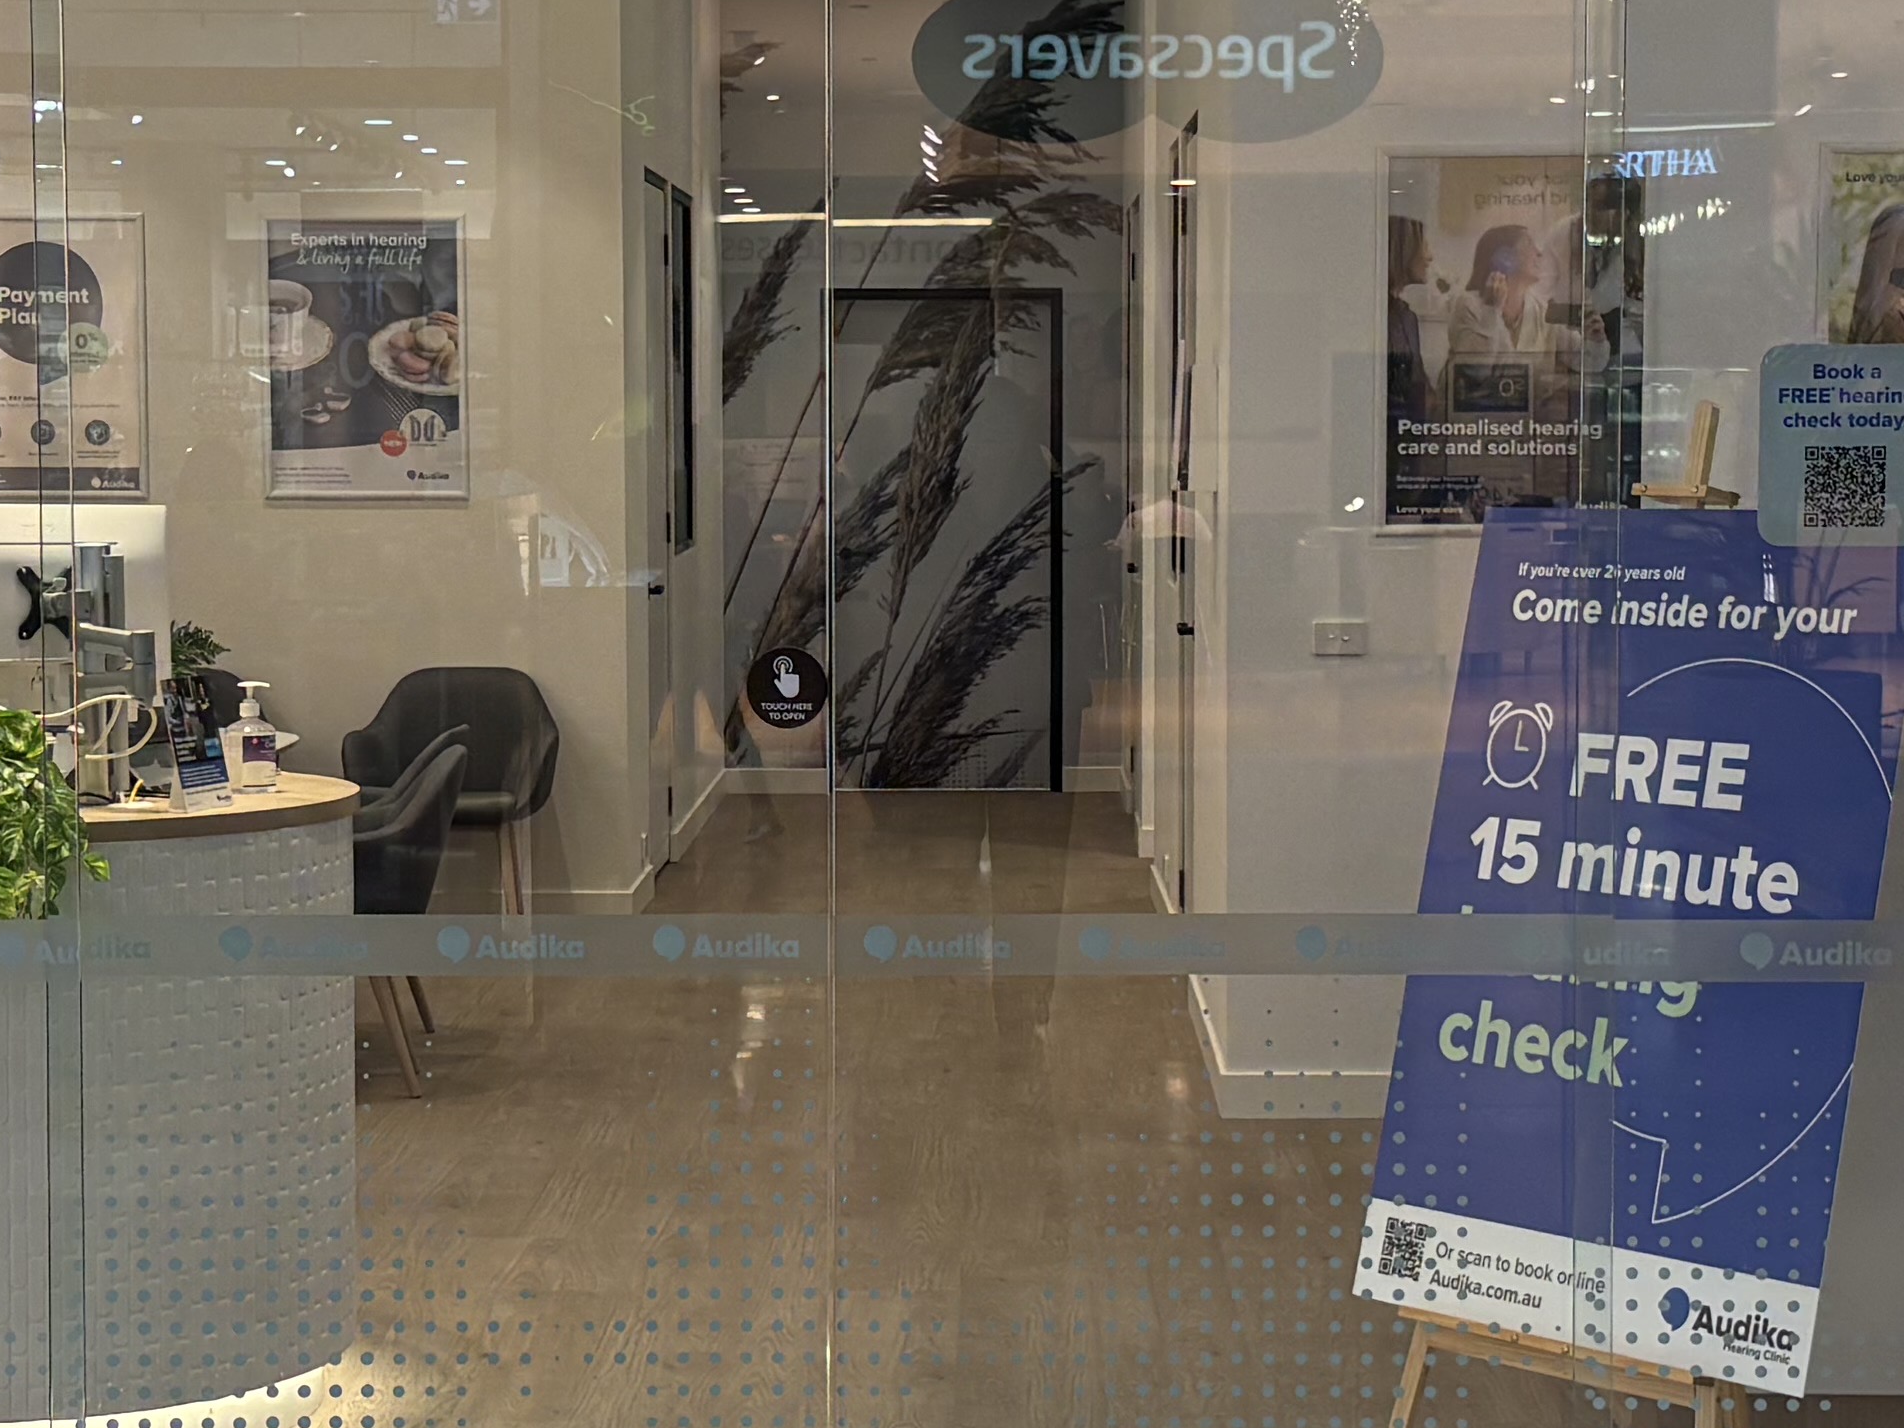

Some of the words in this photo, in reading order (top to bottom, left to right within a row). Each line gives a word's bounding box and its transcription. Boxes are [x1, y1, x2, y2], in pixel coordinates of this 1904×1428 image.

[291, 233, 347, 247] Experts
[351, 233, 365, 246] in
[369, 233, 428, 249] hearing
[1813, 363, 1865, 380] Book
[1869, 367, 1882, 380] a
[1397, 418, 1523, 436] Personalised
[1528, 418, 1602, 439] hearing
[1783, 412, 1842, 429] check
[1397, 441, 1439, 456] care
[1445, 439, 1482, 456] and
[1487, 439, 1578, 456] solutions
[1517, 562, 1530, 577] If
[1624, 566, 1661, 583] years
[1663, 565, 1686, 581] old
[1513, 588, 1602, 624] Come
[1610, 591, 1708, 628] inside
[1718, 595, 1767, 631] for
[1773, 604, 1857, 641] your
[1569, 732, 1751, 812] FREE
[1469, 816, 1542, 885] 15
[1556, 826, 1800, 915] minute
[476, 933, 586, 960] Audika
[692, 933, 801, 960] Audika
[903, 933, 1012, 960] Audika
[1779, 940, 1893, 969] Audika
[1439, 1001, 1628, 1089] check
[1435, 1241, 1457, 1261] Or
[1457, 1249, 1492, 1272] scan
[1496, 1253, 1512, 1274] to
[1514, 1257, 1554, 1283] book
[1429, 1268, 1543, 1310] Audika.com.au
[1692, 1304, 1798, 1352] Audika
[1722, 1341, 1761, 1362] Hearing
[1763, 1347, 1791, 1367] Clinic
